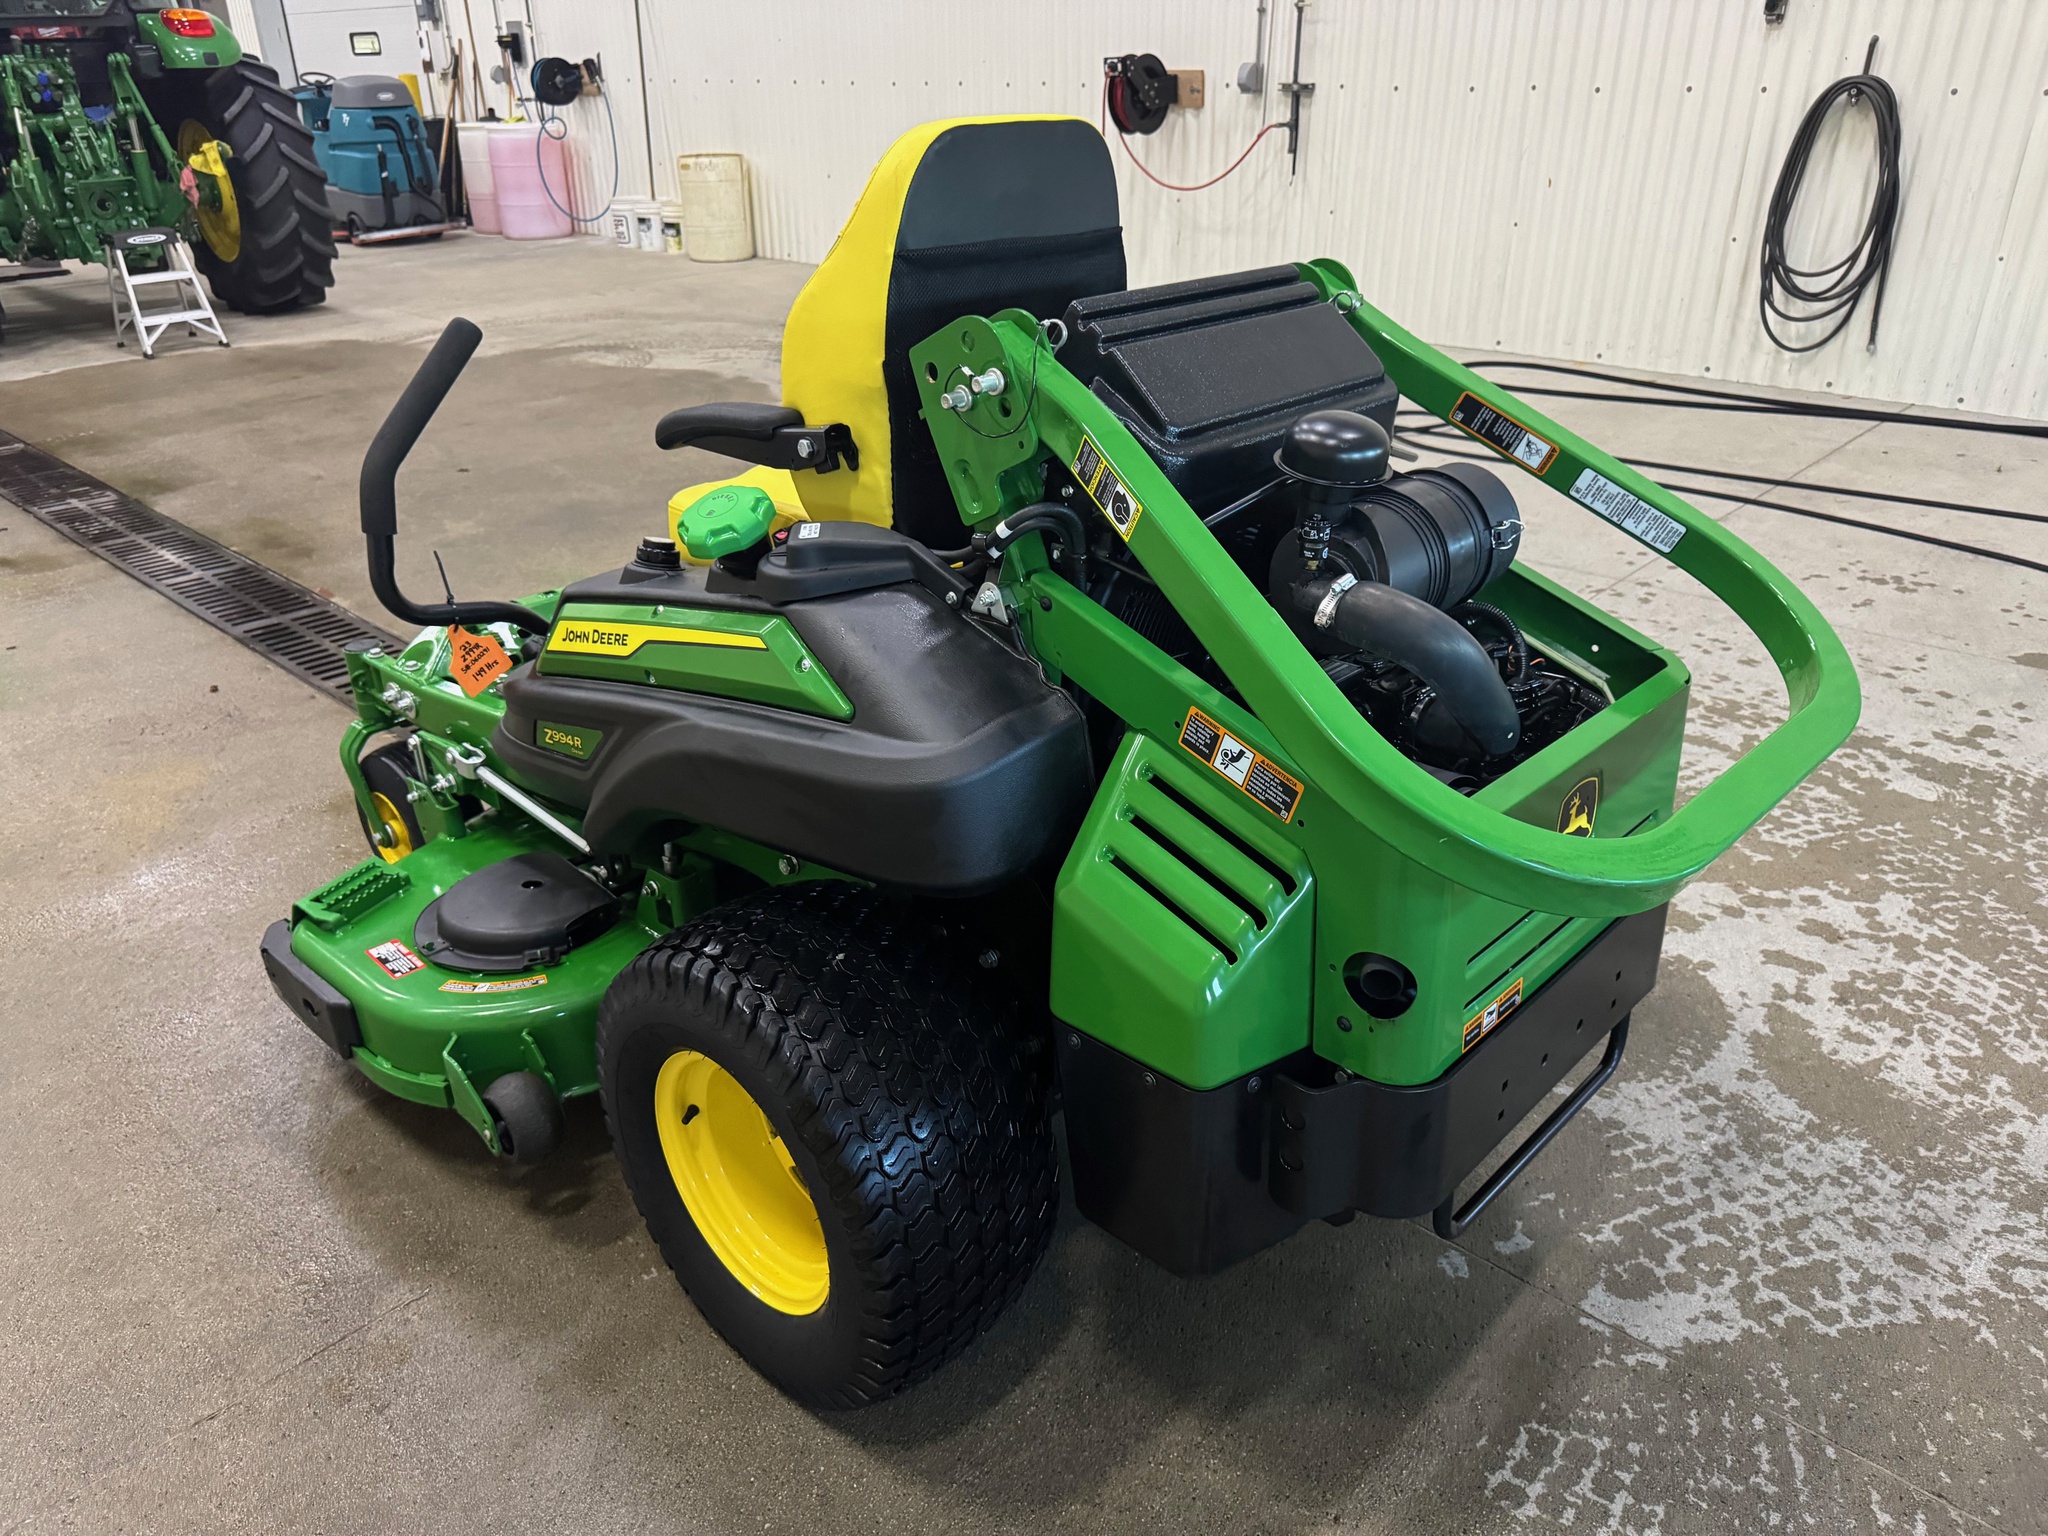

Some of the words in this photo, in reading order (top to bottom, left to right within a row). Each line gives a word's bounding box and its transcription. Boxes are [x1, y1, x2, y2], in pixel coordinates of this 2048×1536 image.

[1124, 511, 1138, 539] CAUTION
[562, 627, 590, 643] JOHN
[591, 629, 628, 646] DEERE
[460, 642, 484, 663] Z994R
[472, 667, 487, 682] 149
[484, 659, 500, 672] Hrs
[544, 728, 582, 748] Z994R
[1265, 761, 1297, 788] ADVERTENCIA
